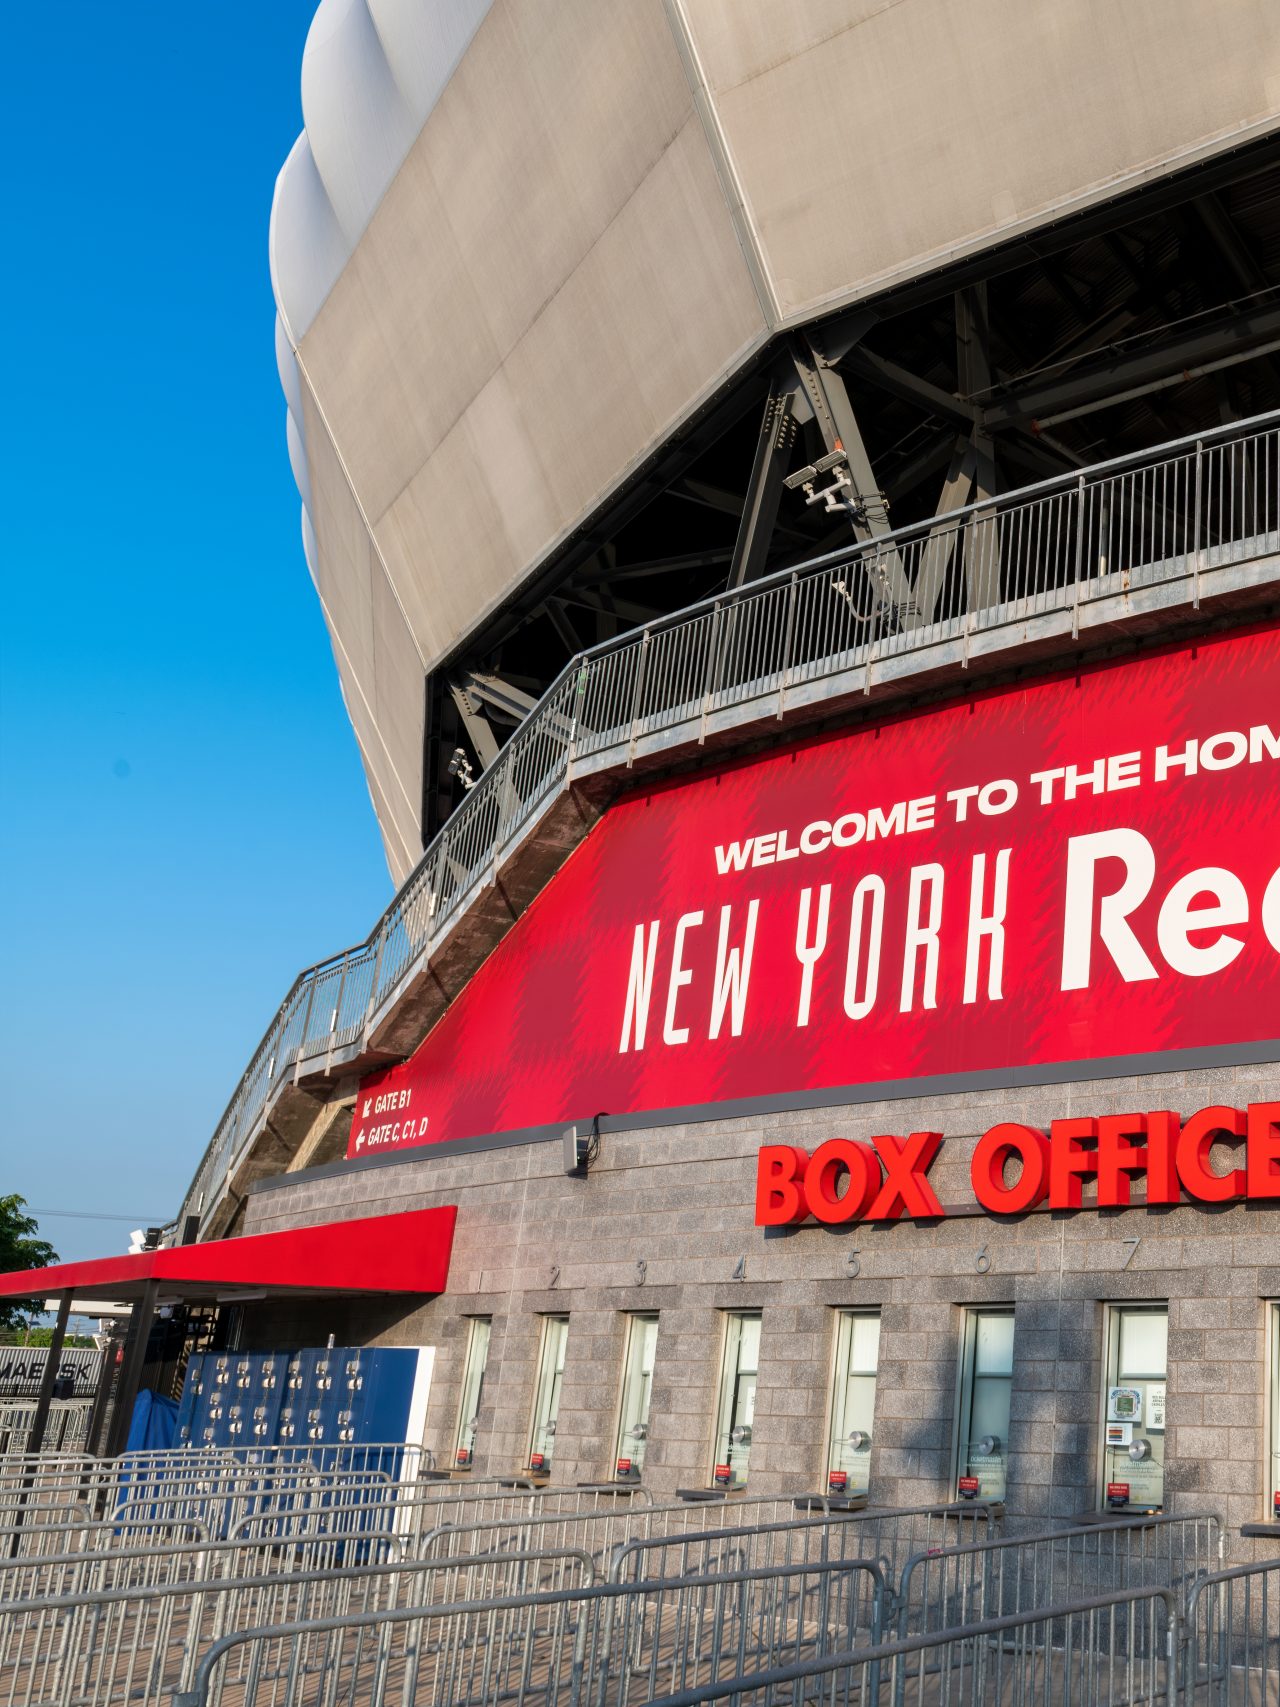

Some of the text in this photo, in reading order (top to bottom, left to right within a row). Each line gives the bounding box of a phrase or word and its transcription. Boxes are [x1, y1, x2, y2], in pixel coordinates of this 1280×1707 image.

[714, 795, 936, 875] WELCOME
[946, 780, 1019, 823] TO
[1030, 751, 1141, 806] THE
[618, 899, 760, 1054] NEW
[795, 848, 1013, 1027] YORK
[374, 1088, 412, 1114] GATE B1
[367, 1124, 392, 1146] GATE
[402, 1119, 416, 1140] C1,
[419, 1117, 428, 1137] D
[755, 1131, 945, 1227] BOX
[732, 1254, 746, 1283] 4
[846, 1249, 861, 1279] 5
[975, 1243, 991, 1274] 6
[1122, 1237, 1142, 1271] 7
[551, 1265, 561, 1290] 2
[636, 1259, 647, 1287] 3
